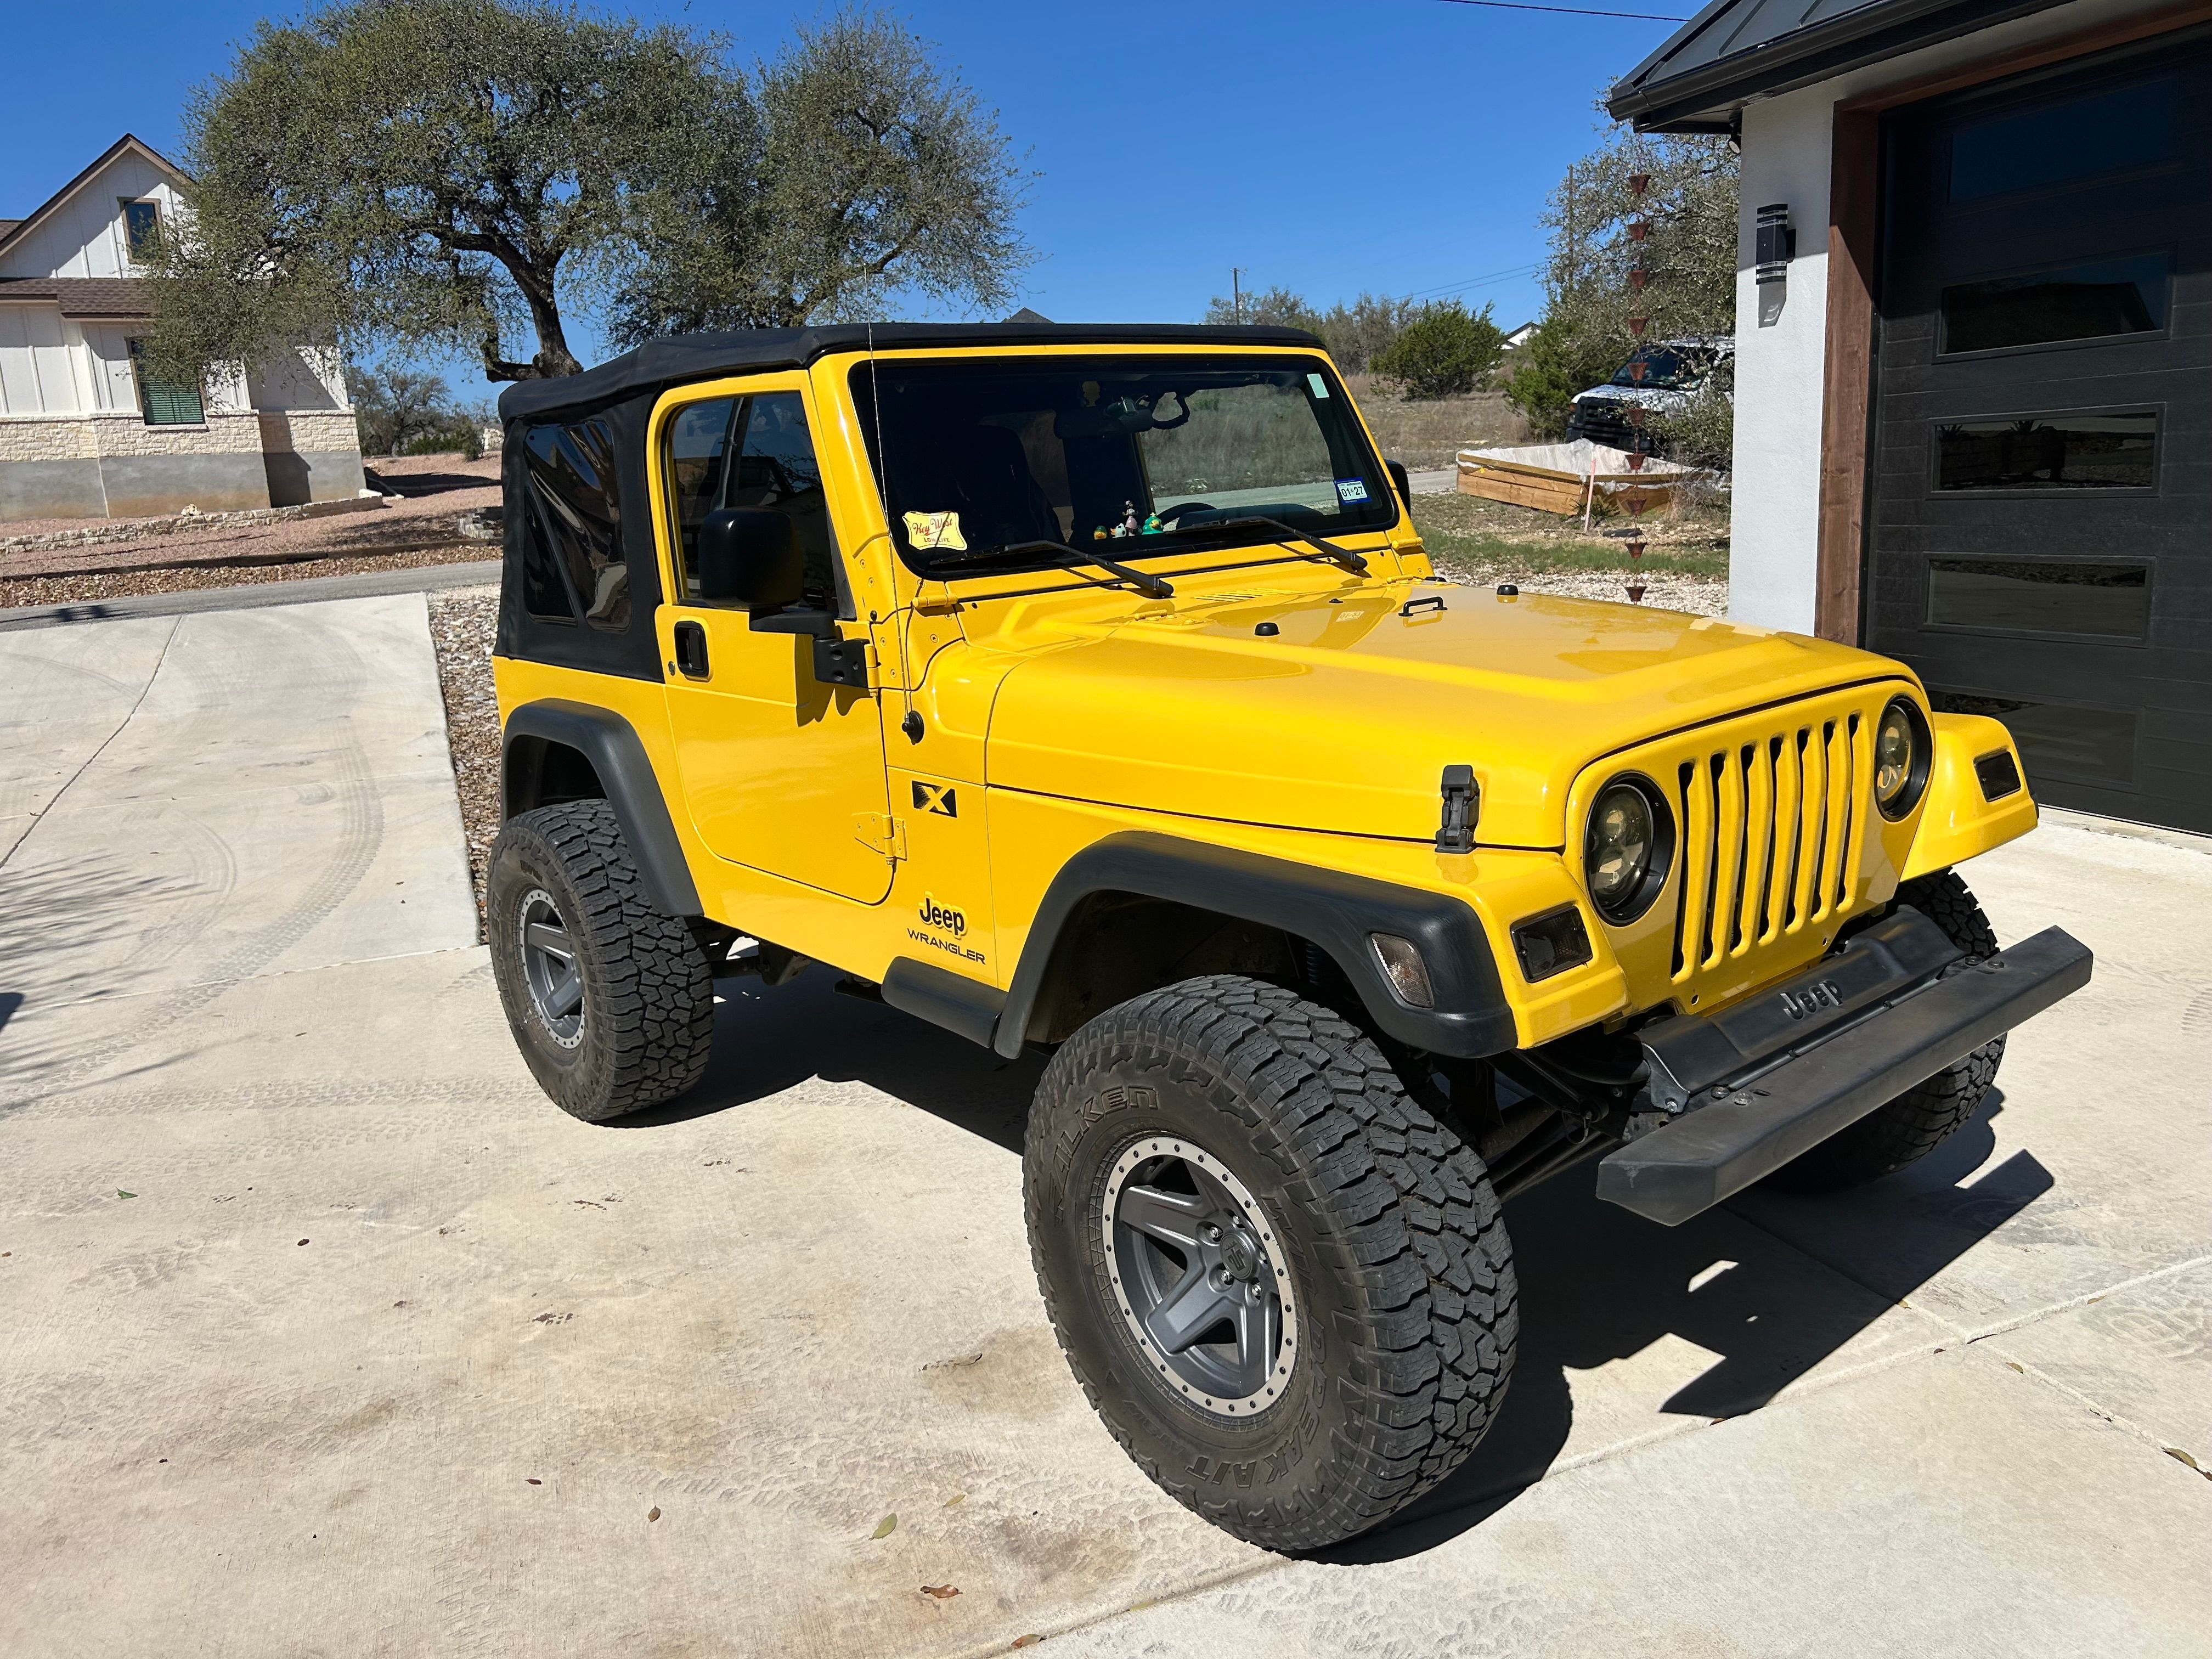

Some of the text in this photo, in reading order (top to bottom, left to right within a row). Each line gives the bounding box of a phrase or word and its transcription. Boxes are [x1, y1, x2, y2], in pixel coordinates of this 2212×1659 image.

[1341, 487, 1363, 496] 01 27
[912, 523, 930, 536] Key
[918, 898, 966, 936] Jeep
[906, 927, 986, 965] WRANGLER
[1780, 979, 1843, 1020] Jeep
